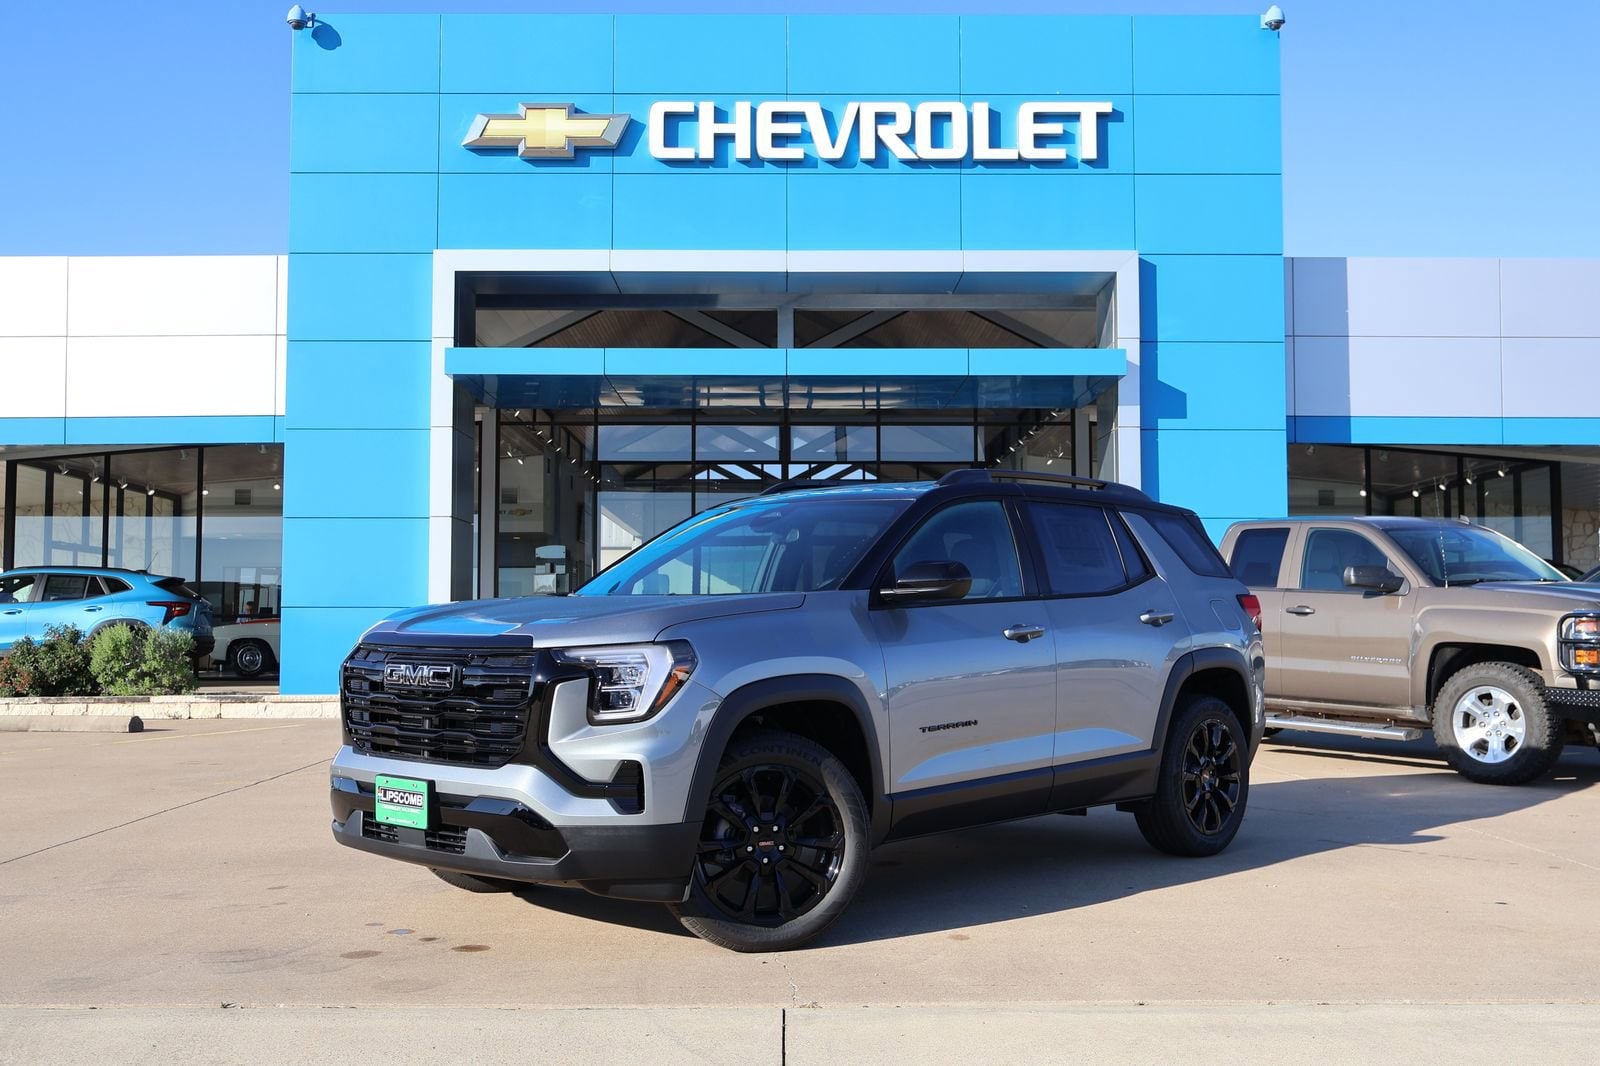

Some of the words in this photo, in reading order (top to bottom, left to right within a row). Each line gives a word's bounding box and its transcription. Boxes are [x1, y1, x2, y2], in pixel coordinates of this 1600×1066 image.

[648, 101, 1113, 162] CHEVROLET
[385, 664, 451, 688] GMC
[919, 719, 978, 733] TERRAIN
[381, 788, 423, 806] LIPSCOMB
